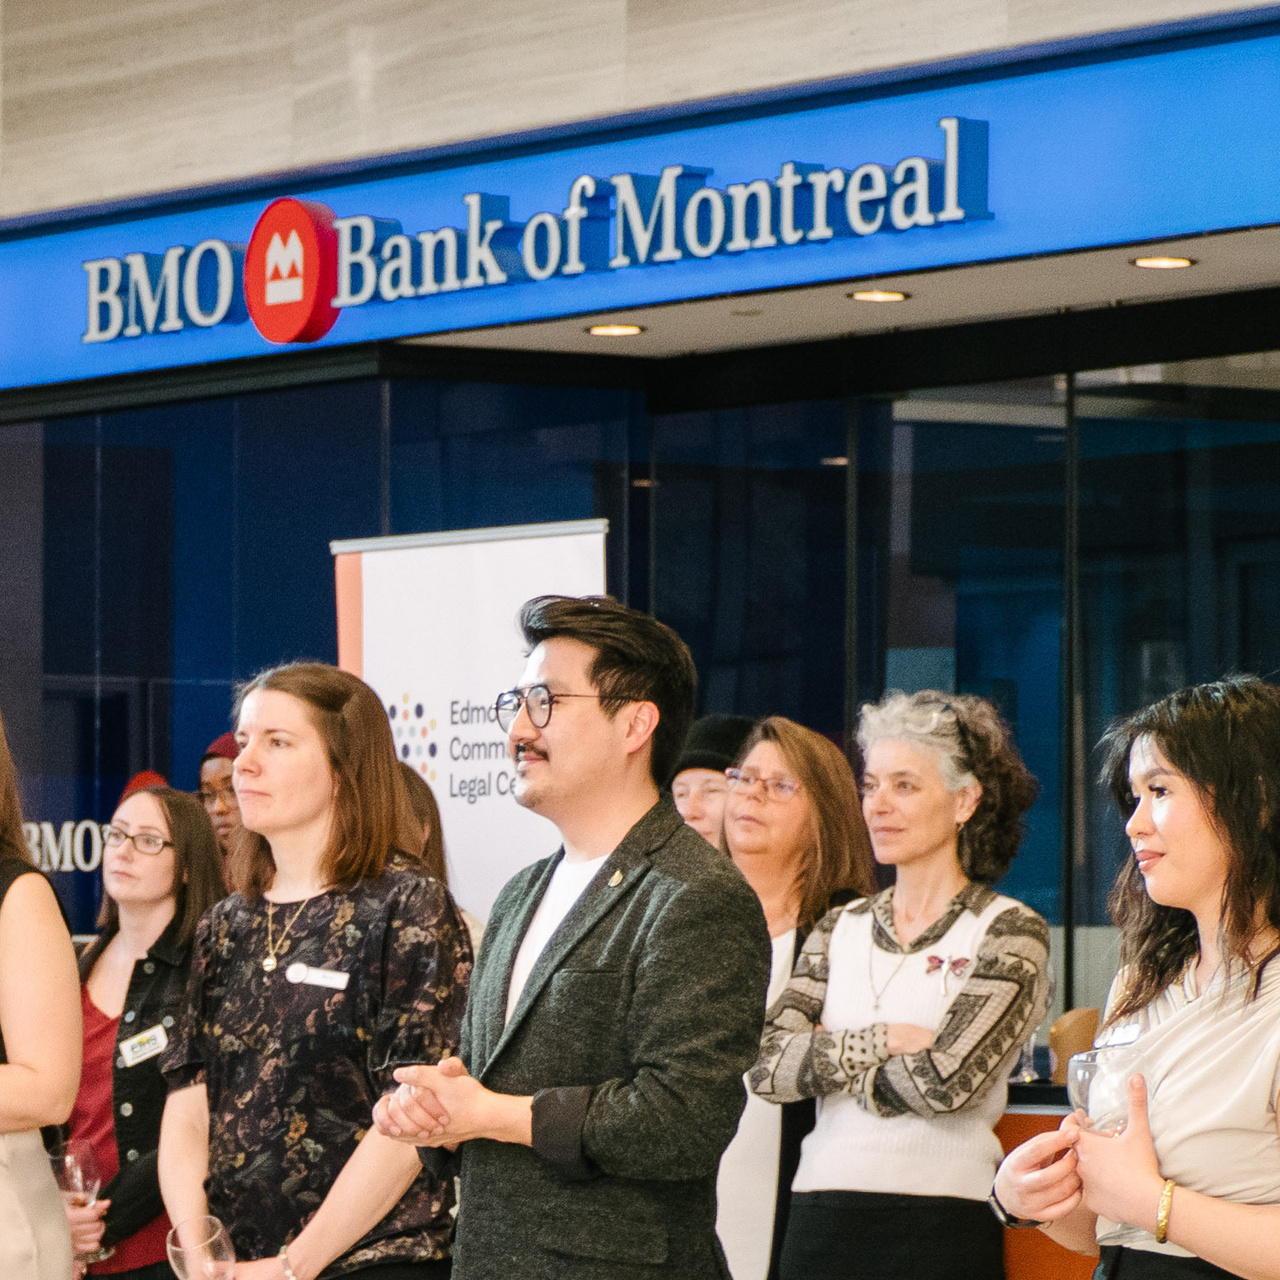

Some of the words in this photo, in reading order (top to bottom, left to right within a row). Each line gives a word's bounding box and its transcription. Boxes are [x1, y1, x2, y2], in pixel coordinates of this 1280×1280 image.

[82, 239, 235, 344] BMO
[330, 192, 508, 309] Bank
[521, 174, 597, 281] of
[609, 116, 966, 269] Montreal
[450, 699, 497, 725] Edmo
[449, 736, 510, 761] Comm
[449, 771, 492, 804] Legal
[496, 771, 516, 796] Ce
